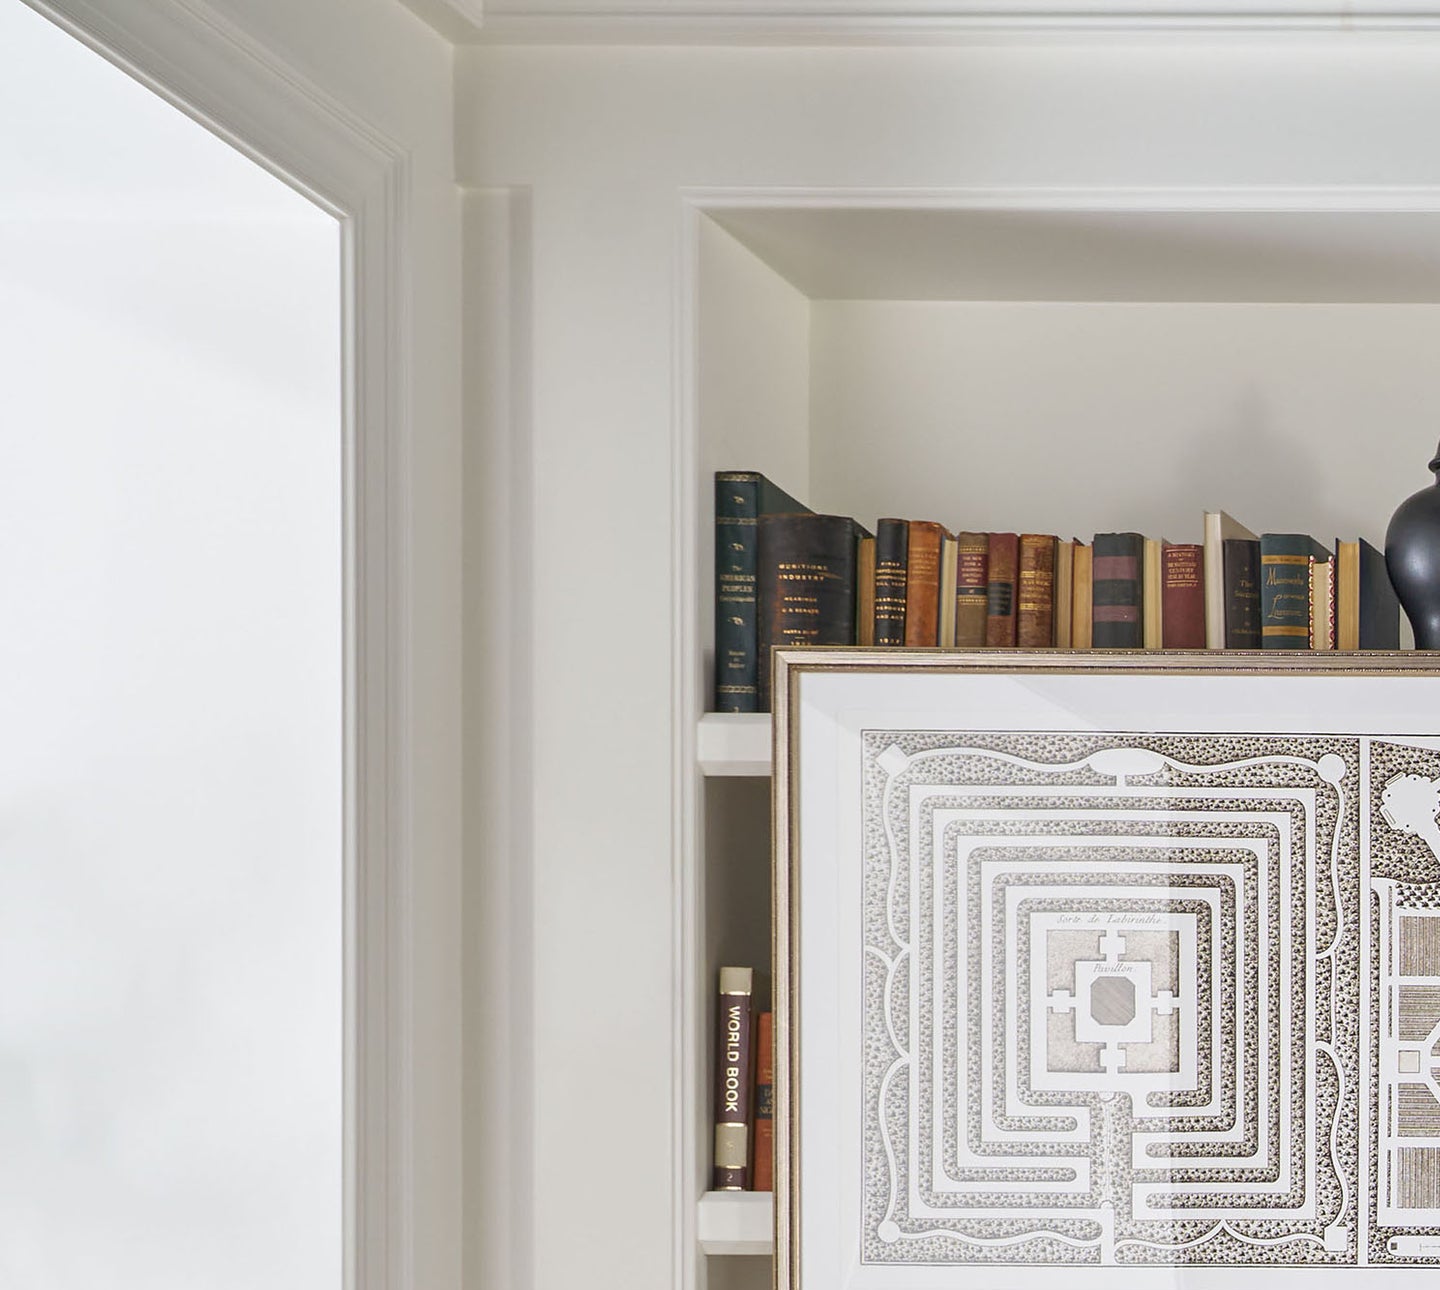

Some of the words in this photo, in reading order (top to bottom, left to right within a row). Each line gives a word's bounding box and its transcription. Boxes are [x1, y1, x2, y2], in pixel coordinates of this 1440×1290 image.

[1088, 915, 1101, 923] de
[726, 1005, 741, 1062] WORLD
[725, 1067, 739, 1112] BOOK
